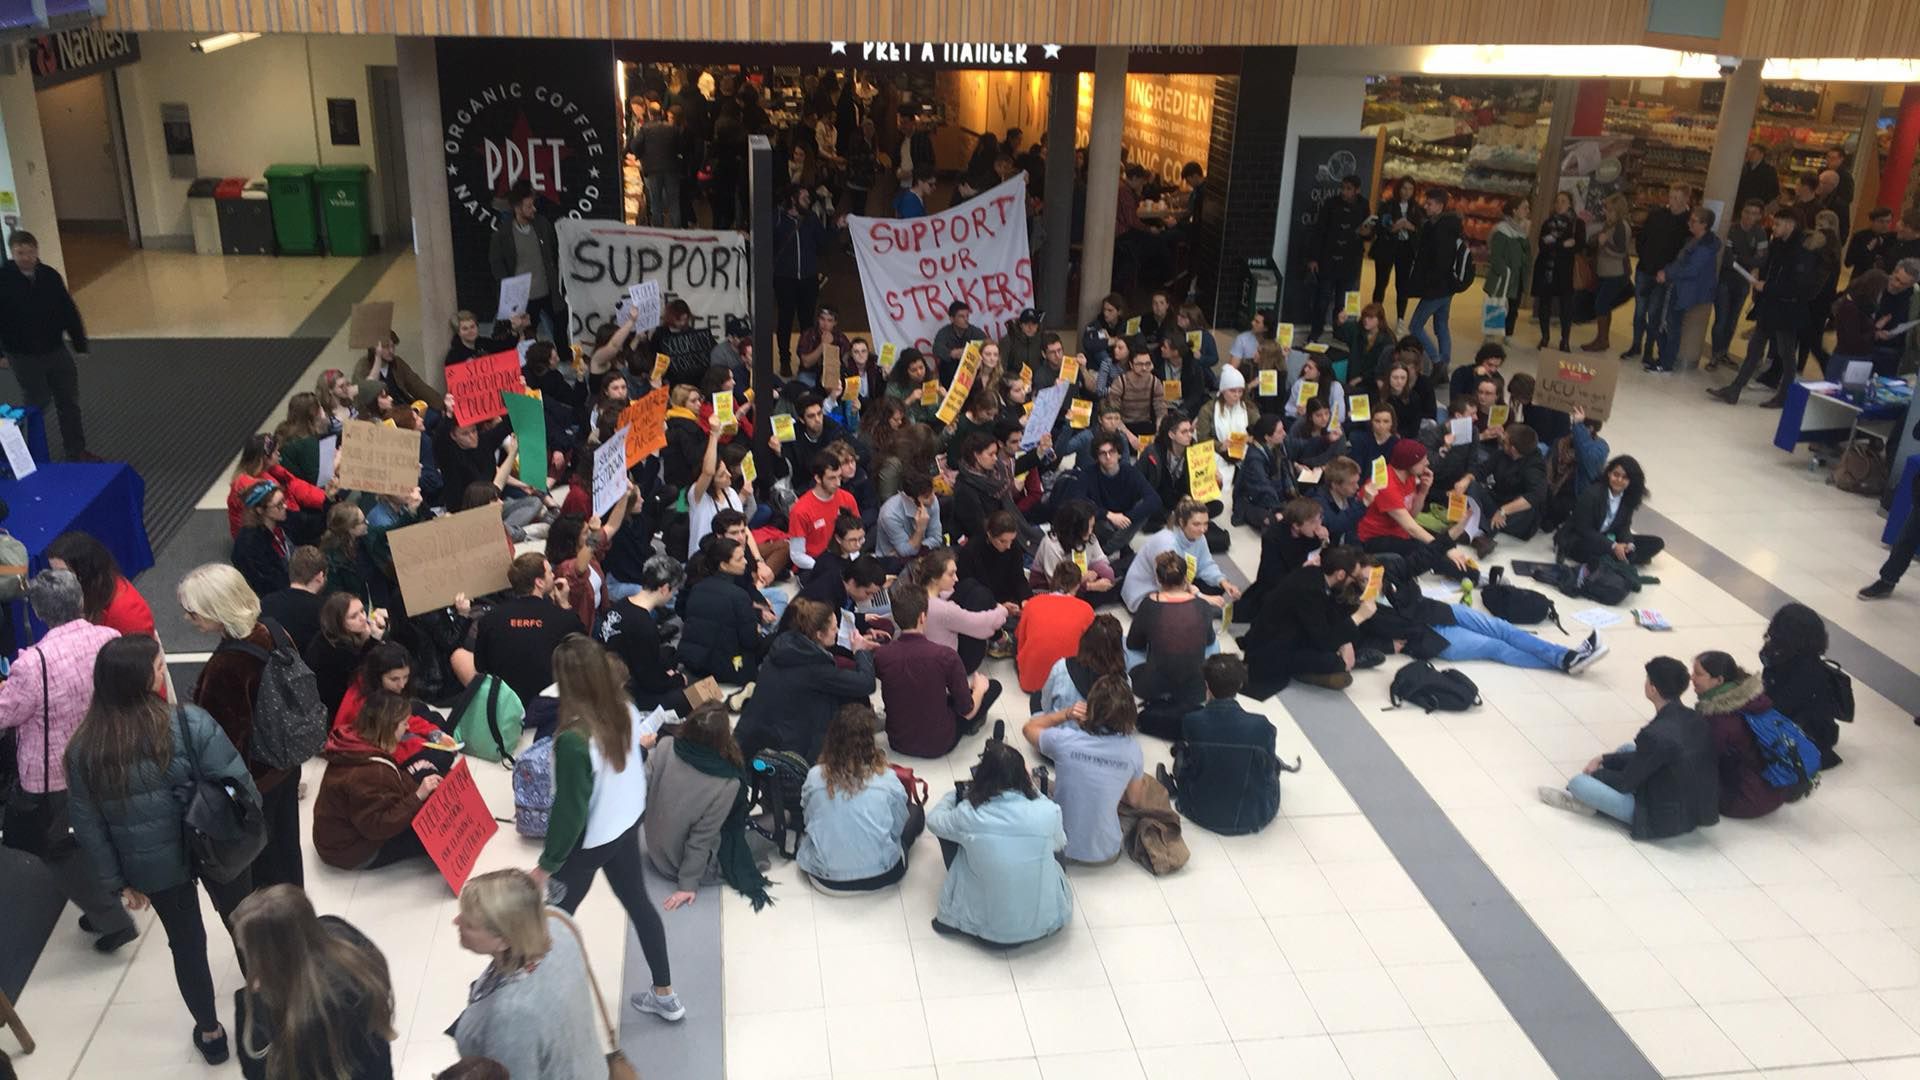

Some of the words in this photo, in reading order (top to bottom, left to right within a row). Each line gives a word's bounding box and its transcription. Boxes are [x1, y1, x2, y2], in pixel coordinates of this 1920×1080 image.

[56, 26, 130, 71] NatWest
[445, 82, 522, 154] ORGANIC
[534, 85, 604, 157] COFFEE
[870, 195, 1015, 254] SUPPORT
[571, 239, 744, 291] SUPPORT
[919, 248, 977, 279] OUR
[885, 258, 1034, 321] STRIKERS
[1543, 379, 1575, 398] UCU
[509, 619, 543, 628] EERFC
